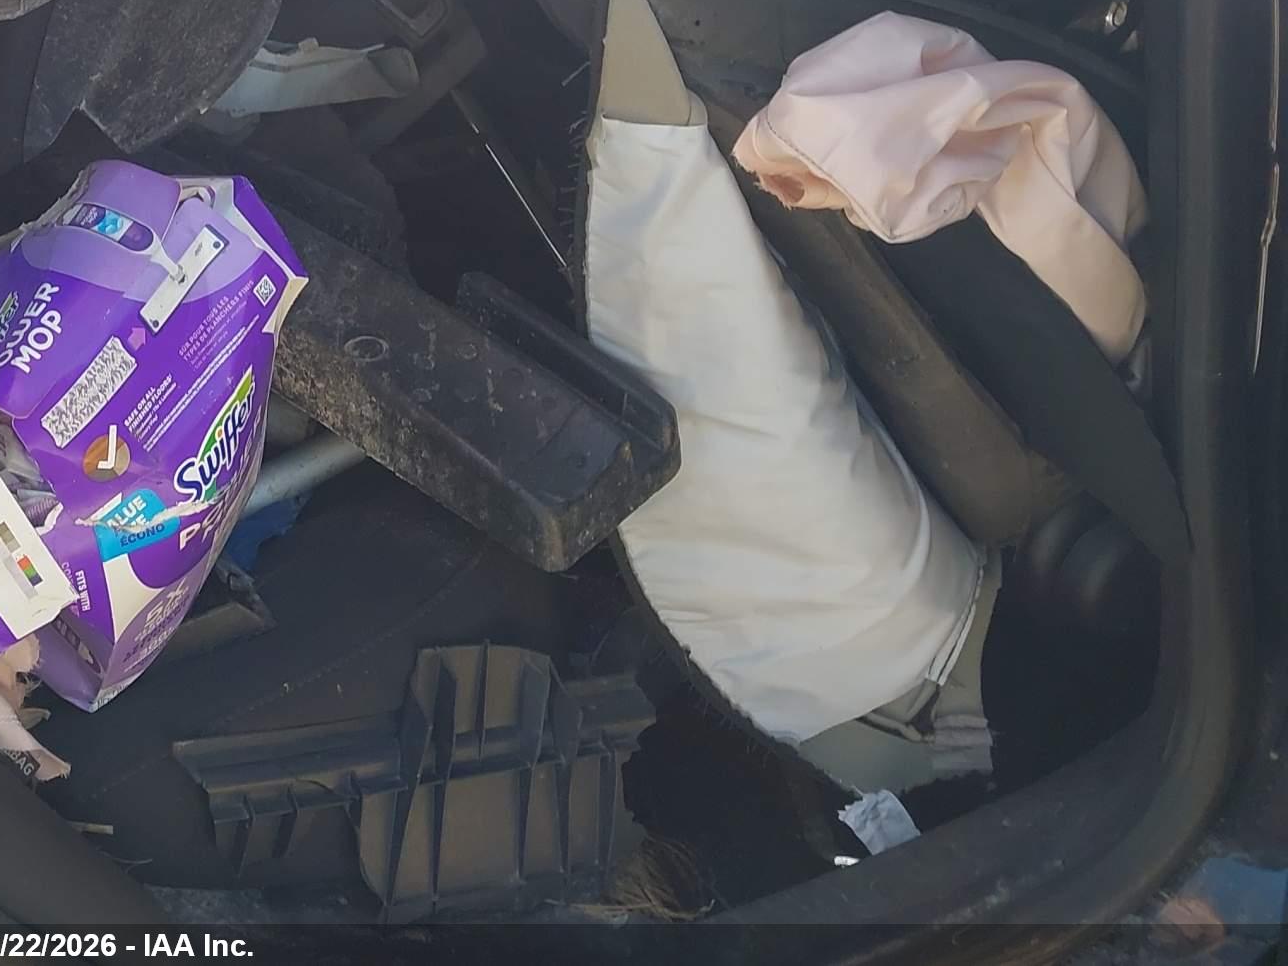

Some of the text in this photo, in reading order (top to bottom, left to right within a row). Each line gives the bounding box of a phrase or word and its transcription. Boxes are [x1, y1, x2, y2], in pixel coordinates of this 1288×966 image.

[12, 310, 62, 373] MOP
[124, 386, 156, 427] SAFE ON ALL
[128, 400, 153, 433] FINISHED
[174, 374, 255, 505] Swiffer
[107, 495, 147, 529] ALUE
[75, 570, 91, 612] FITS WITH
